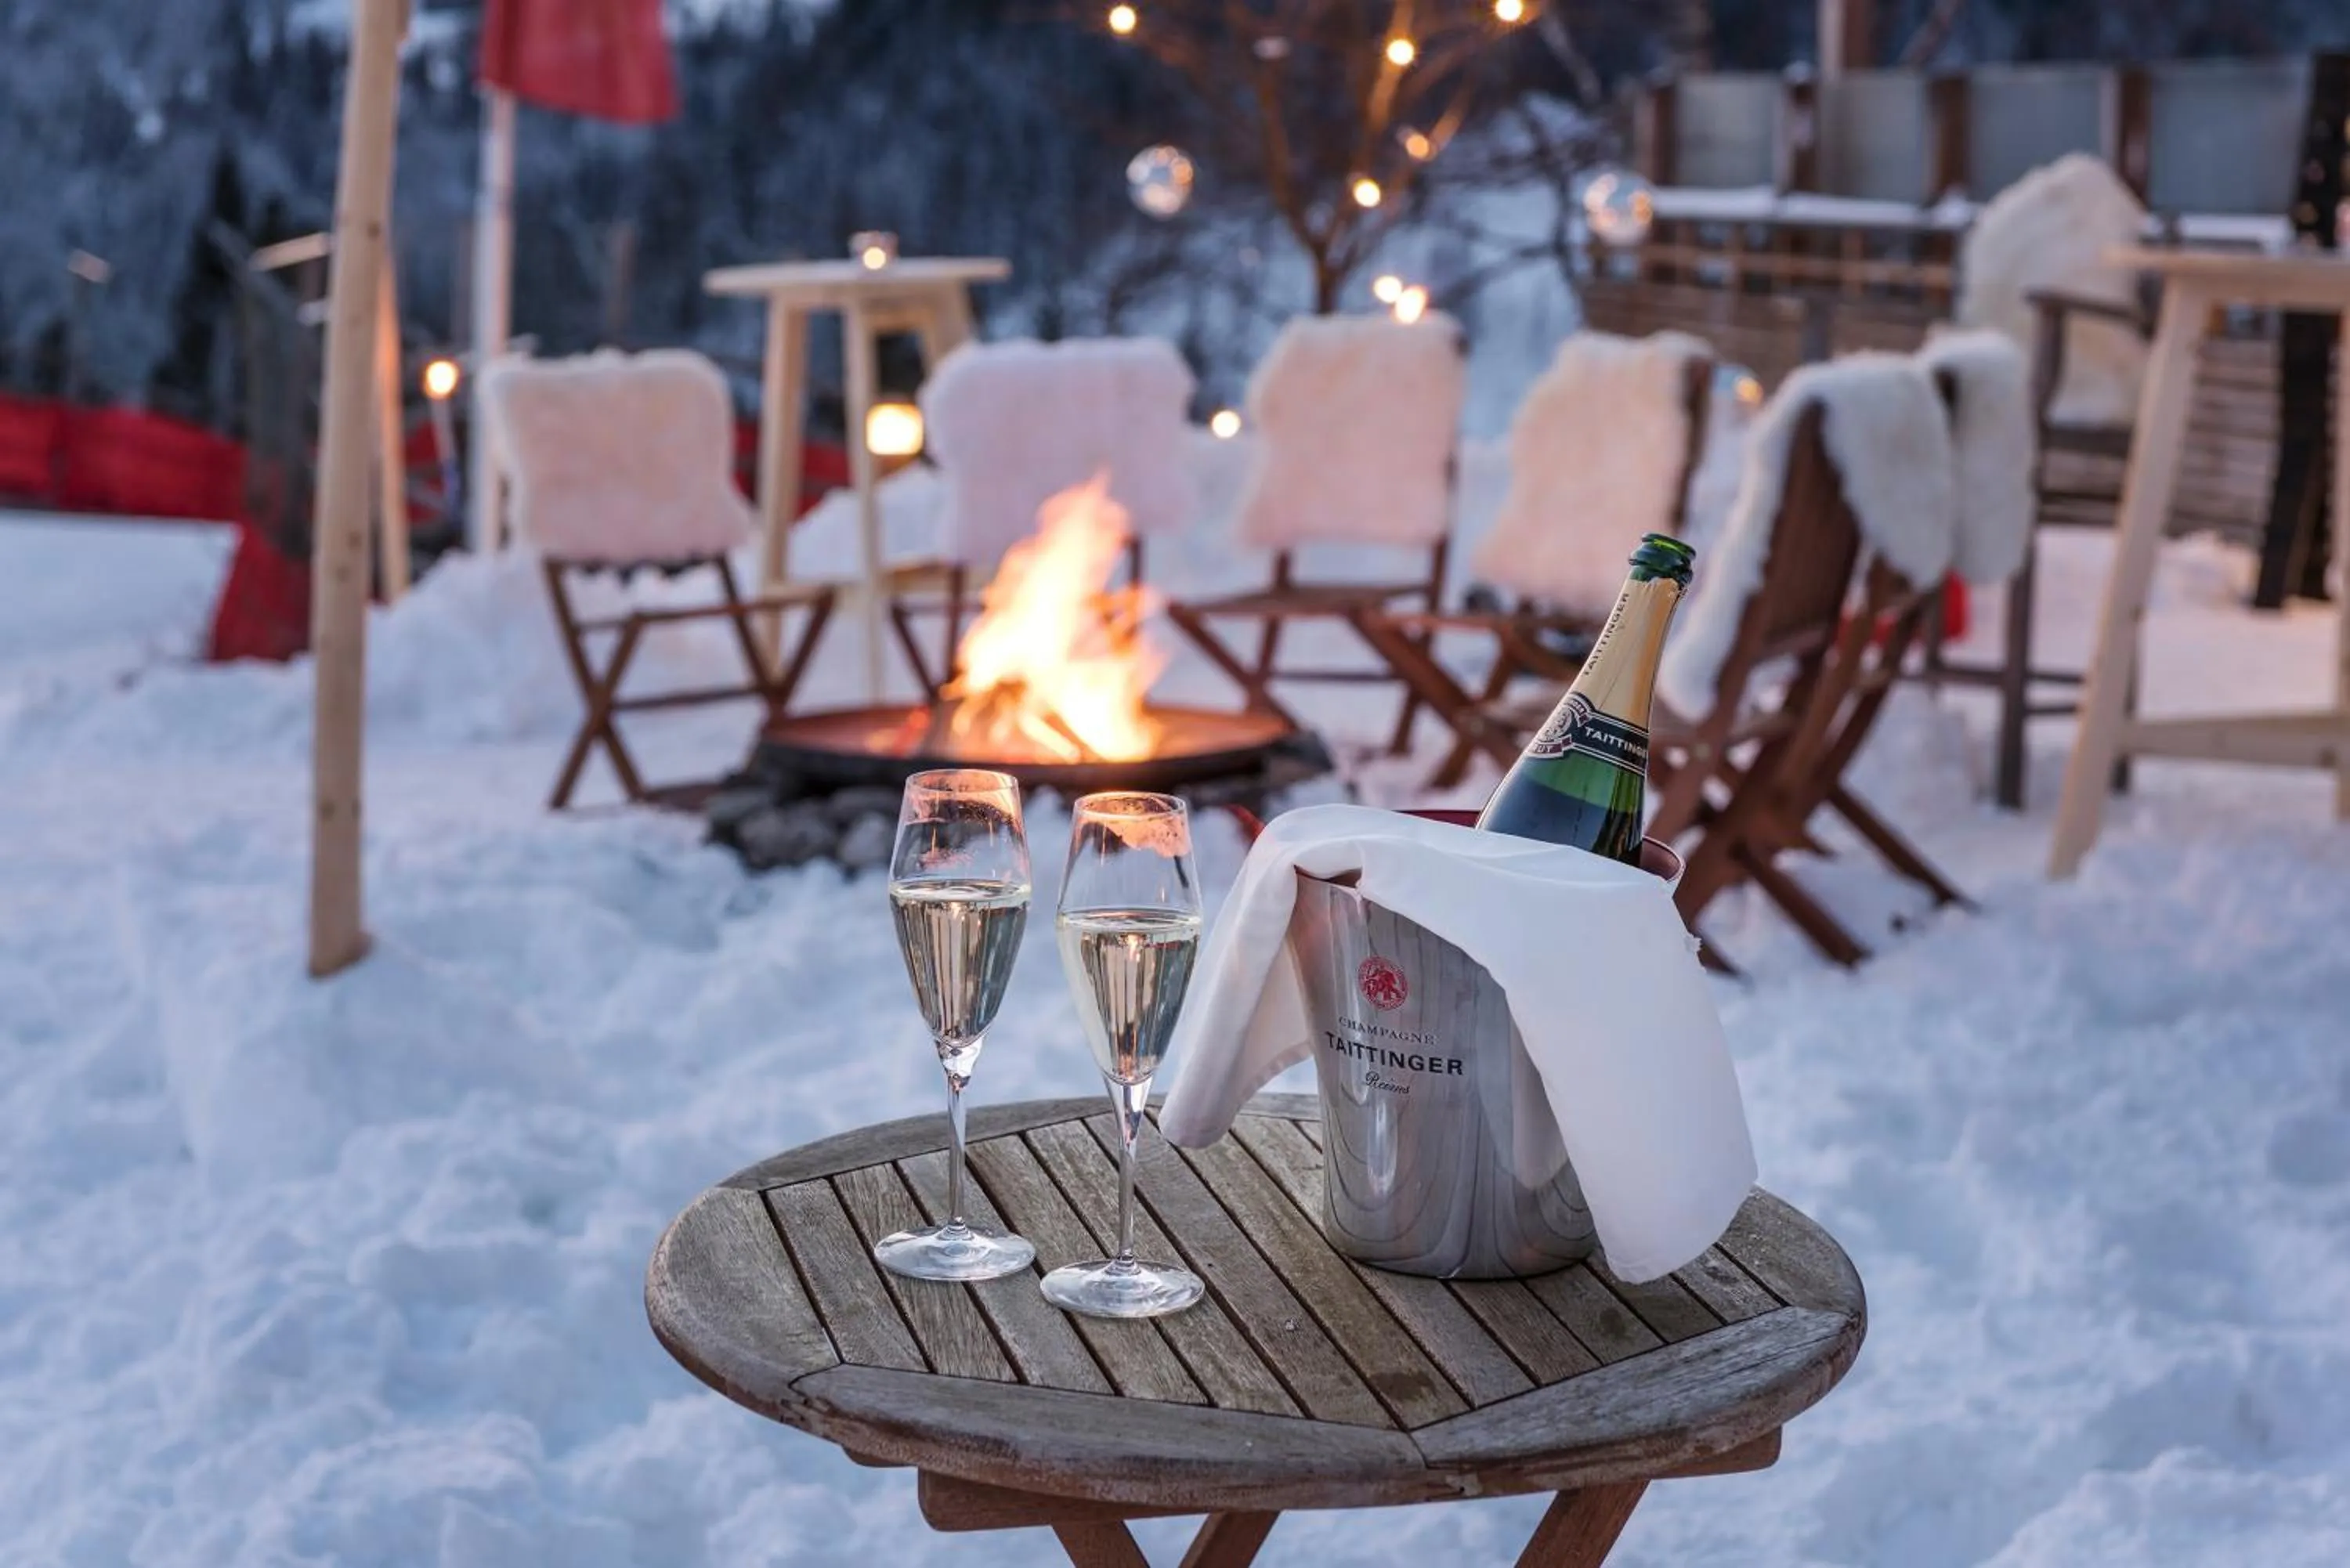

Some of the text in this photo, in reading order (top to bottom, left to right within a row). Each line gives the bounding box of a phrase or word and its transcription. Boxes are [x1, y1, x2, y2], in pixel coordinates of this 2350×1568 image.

[1583, 593, 1629, 676] TAITTINGER
[1338, 1016, 1436, 1045] CHAMPAGNE
[1325, 1031, 1464, 1076] TAITTINGER
[1364, 1071, 1411, 1094] Reims
